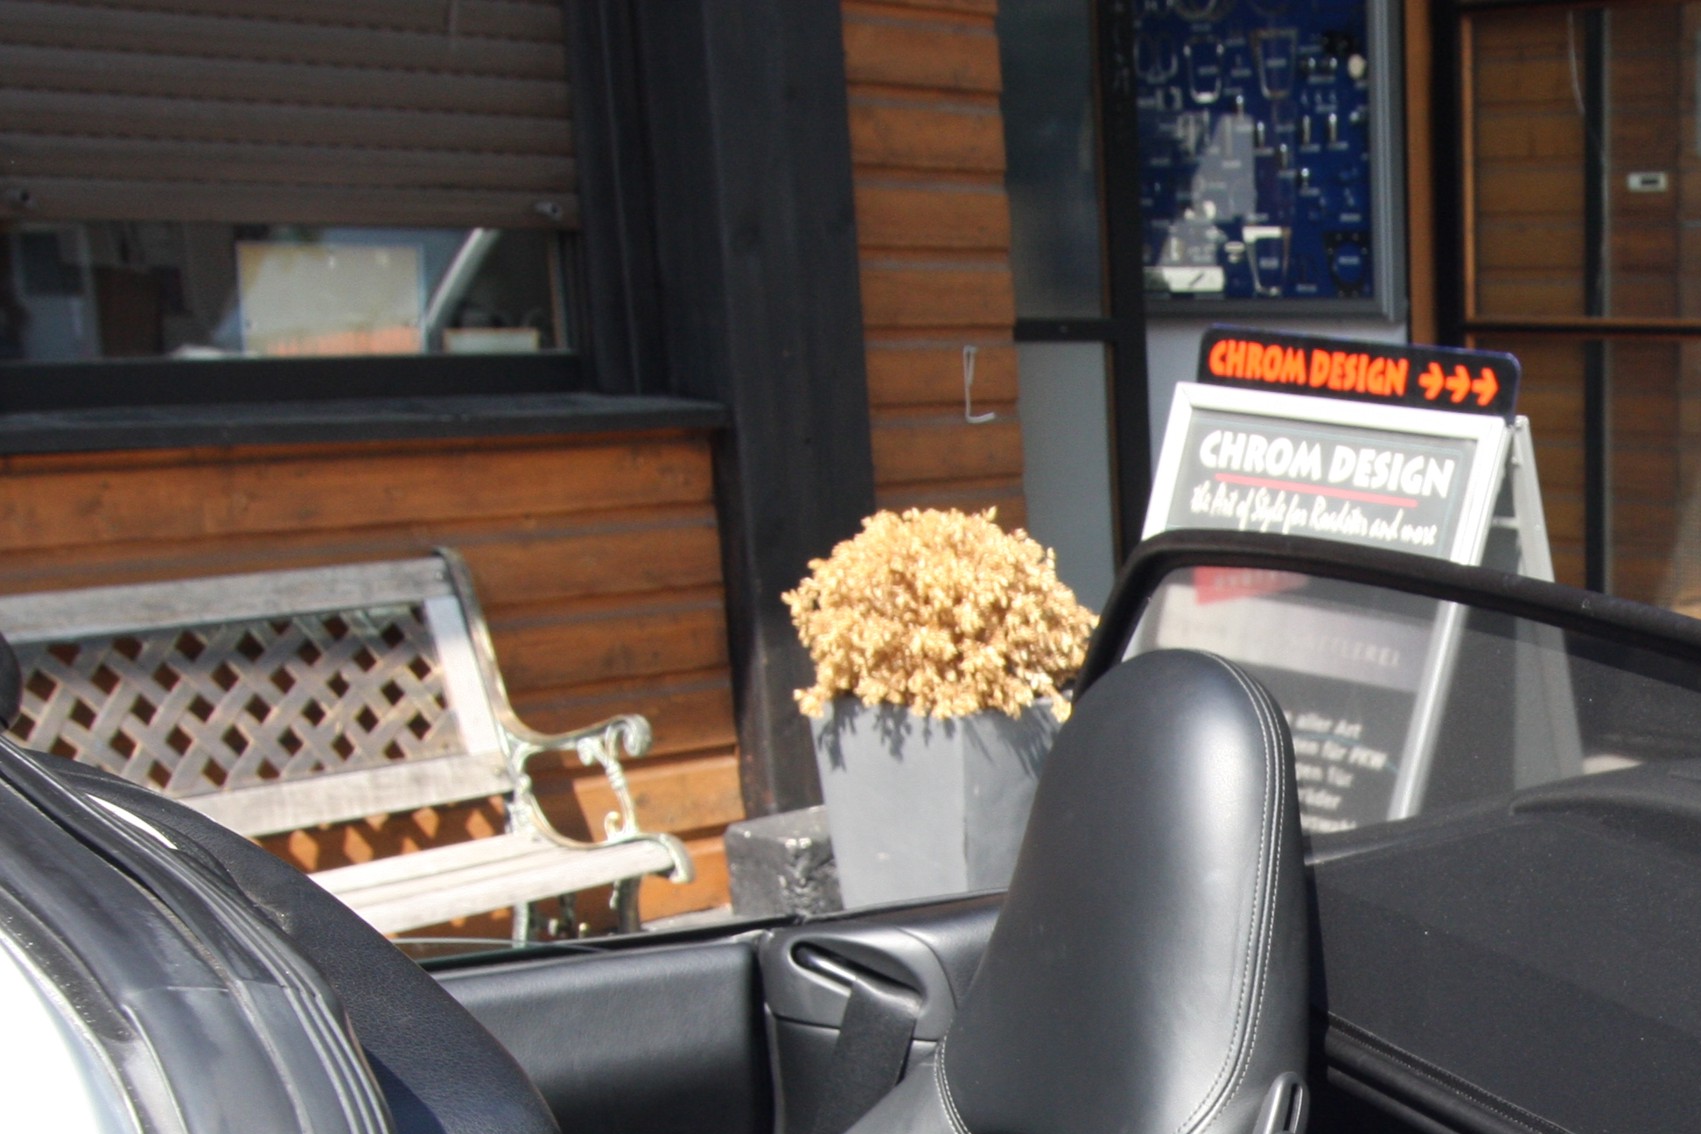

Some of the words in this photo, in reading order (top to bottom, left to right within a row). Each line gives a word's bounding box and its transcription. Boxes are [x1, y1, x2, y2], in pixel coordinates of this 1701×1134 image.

[1208, 338, 1307, 386] CHROM
[1309, 348, 1410, 397] DESIGN
[1199, 429, 1323, 482] CHROM
[1327, 444, 1456, 499] DESIGN
[1190, 480, 1212, 513] the
[1209, 482, 1239, 517] Art
[1236, 488, 1256, 531] of
[1250, 487, 1287, 533] Style
[1281, 493, 1308, 534] for
[1368, 508, 1405, 541] and
[1400, 524, 1438, 546] more
